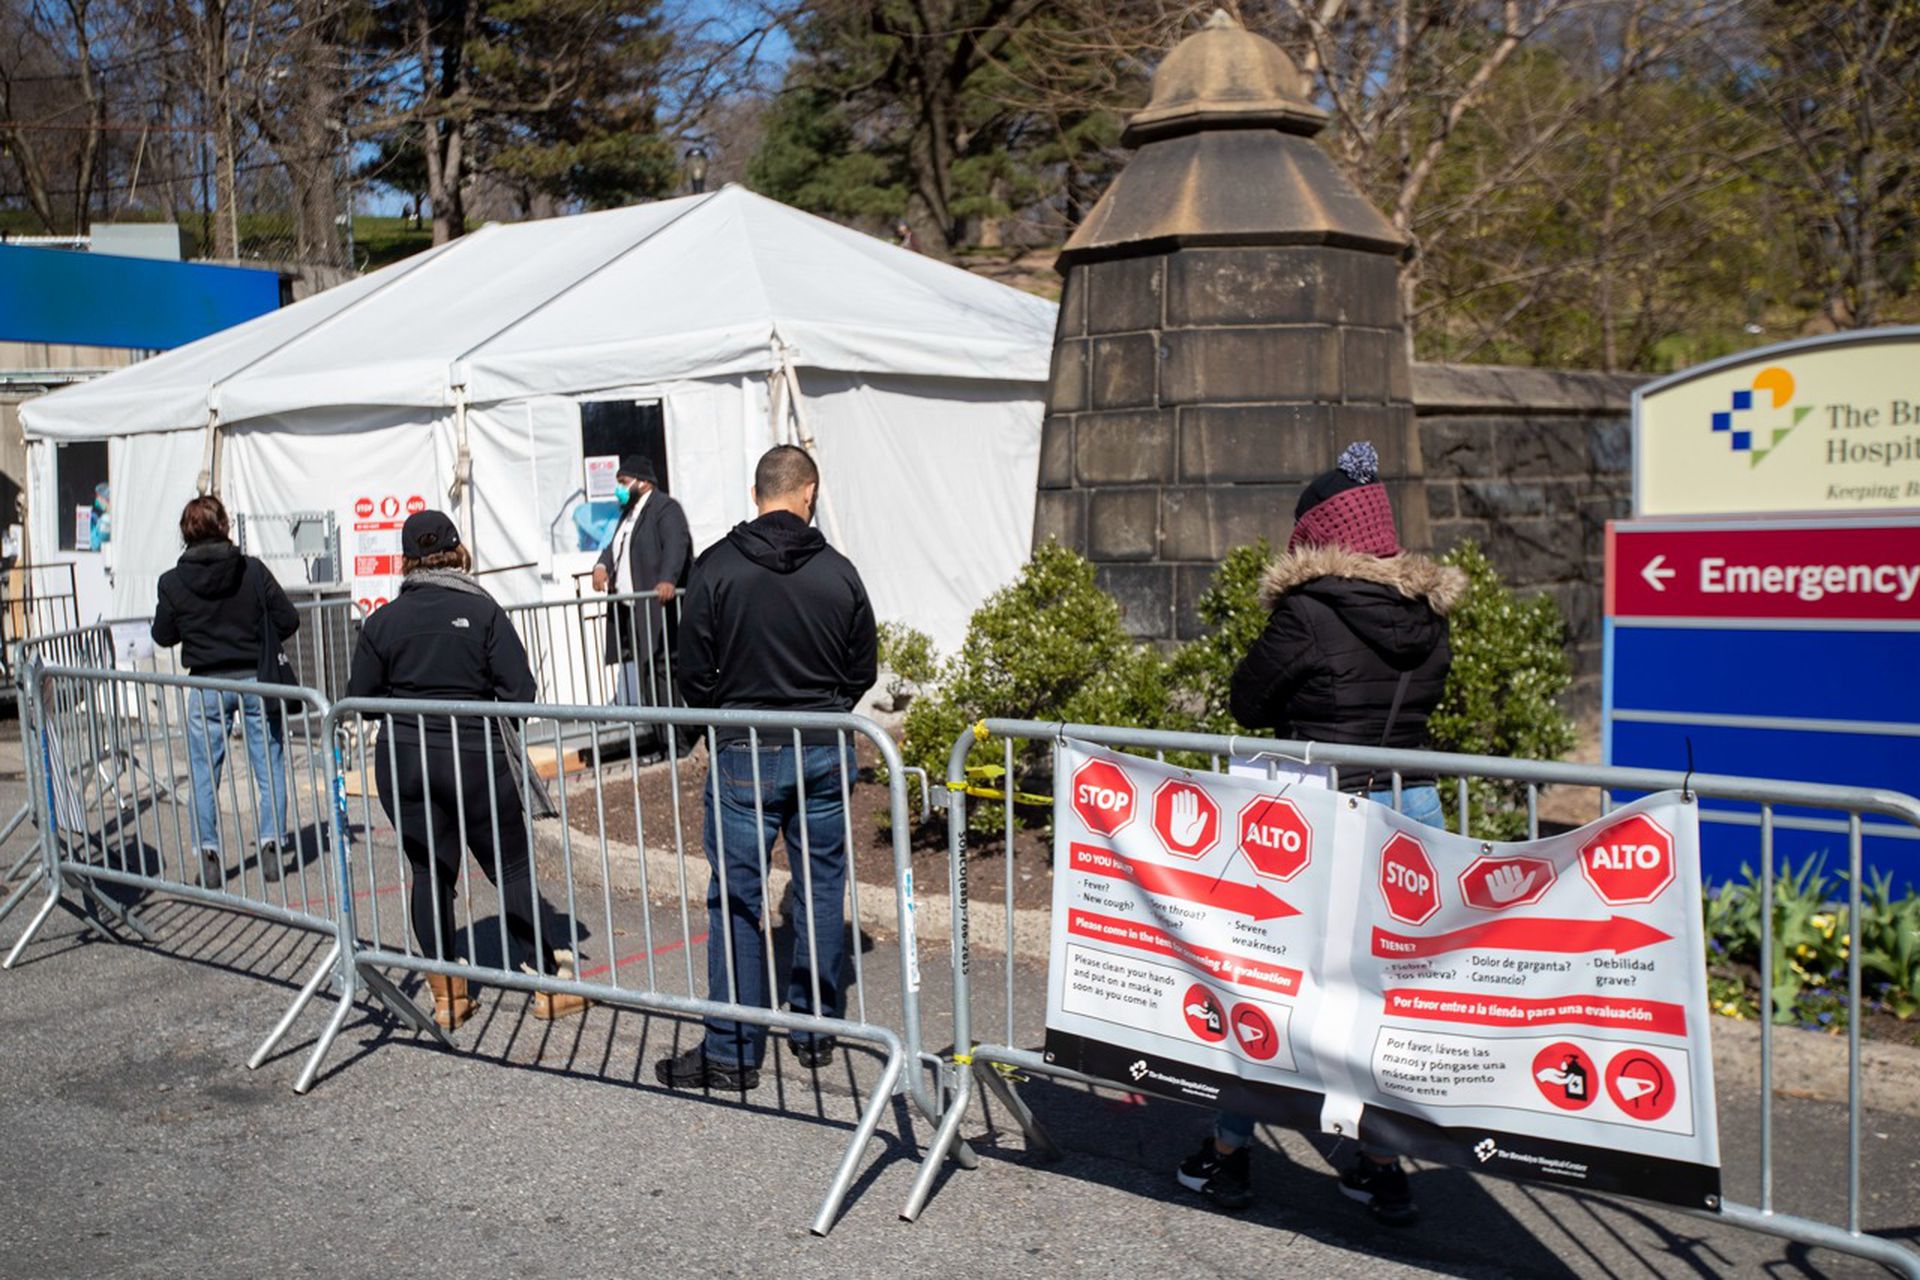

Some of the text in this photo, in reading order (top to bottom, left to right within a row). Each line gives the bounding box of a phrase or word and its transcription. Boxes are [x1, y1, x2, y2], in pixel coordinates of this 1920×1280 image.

[1825, 404, 1880, 429] The
[1826, 484, 1900, 502] Keeping
[1700, 557, 1920, 601] Emergency
[1079, 784, 1128, 812] STOP
[1246, 823, 1301, 851] ALTO
[1078, 851, 1092, 862] DO
[1093, 854, 1111, 867] YOU
[1592, 844, 1661, 870] ALTO
[1084, 879, 1110, 892] Fever?
[1386, 861, 1430, 896] STOP
[1083, 892, 1135, 912] New cough?
[1169, 904, 1206, 920] throat?
[1235, 920, 1268, 936] Severe
[1075, 917, 1102, 932] Please
[1103, 926, 1127, 938] come
[1128, 929, 1138, 939] in
[1139, 931, 1154, 943] the
[1221, 960, 1233, 972] &
[1233, 963, 1292, 987] evaluation
[1232, 936, 1287, 955] weakness?
[1380, 938, 1416, 952] TIENE?
[1075, 953, 1175, 986] Please clean your hands
[1472, 956, 1571, 973] Dolor de garganta?
[1594, 957, 1655, 971] Debilidad
[1074, 968, 1089, 979] and
[1091, 973, 1105, 984] put
[1107, 977, 1118, 986] on
[1128, 981, 1151, 993] mask
[1153, 989, 1163, 997] as
[1418, 970, 1456, 981] nueva?
[1471, 972, 1526, 986] Cansancio?
[1596, 975, 1637, 988] grave?
[1073, 982, 1158, 1009] soon as you come in
[1393, 996, 1411, 1008] Por
[1413, 997, 1438, 1010] favor
[1440, 1001, 1467, 1013] entre
[1476, 1003, 1487, 1015] la
[1488, 1003, 1525, 1018] tienda
[1527, 1009, 1556, 1021] para
[1558, 1005, 1583, 1015] una
[1585, 1005, 1653, 1021] evaluación
[1386, 1037, 1490, 1057] Por favor, lávese las
[1382, 1053, 1506, 1073] manos y póngase una
[1381, 1067, 1495, 1086] máscara tan pronto
[1384, 1081, 1448, 1097] como entre
